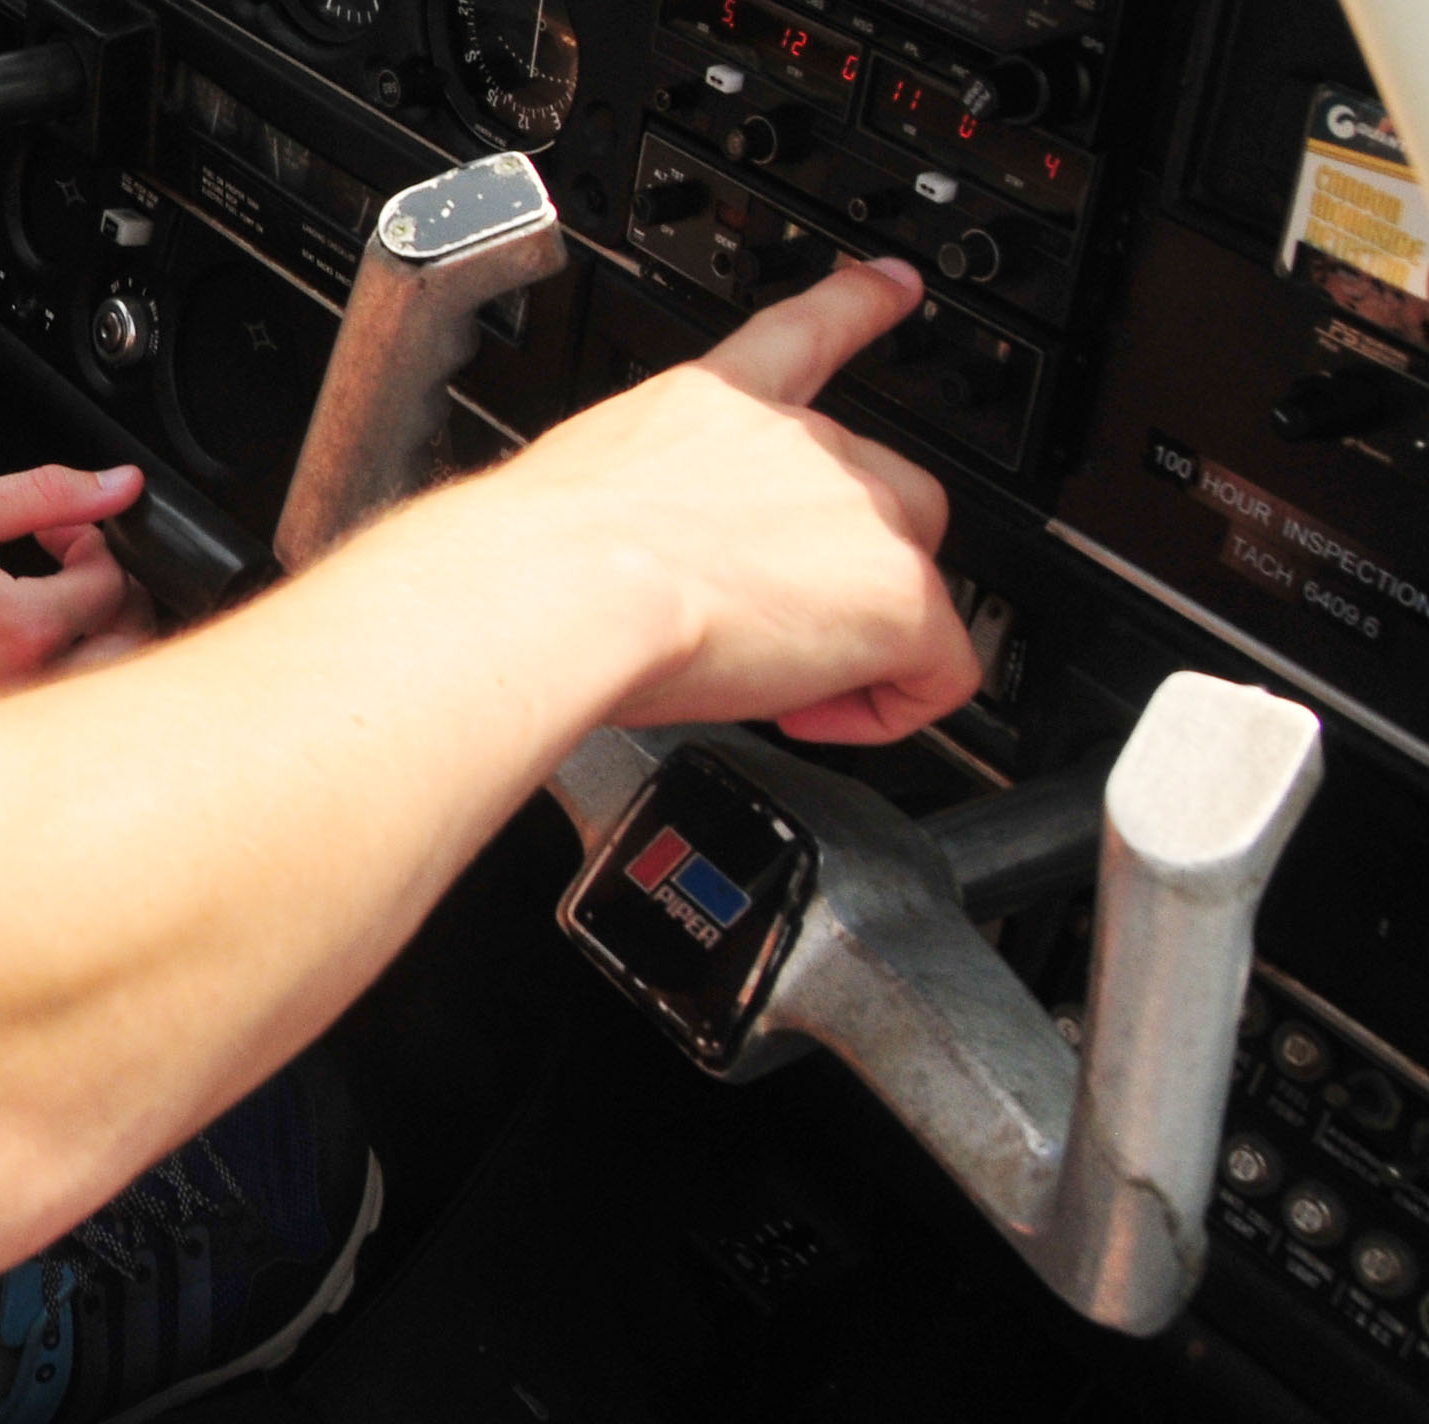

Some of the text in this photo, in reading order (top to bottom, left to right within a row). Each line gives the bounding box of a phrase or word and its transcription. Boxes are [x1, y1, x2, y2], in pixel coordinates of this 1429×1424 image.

[1152, 444, 1193, 480] 100
[1197, 470, 1272, 527] HOUR
[1231, 534, 1296, 588] TACH
[653, 884, 725, 951] PIPER
